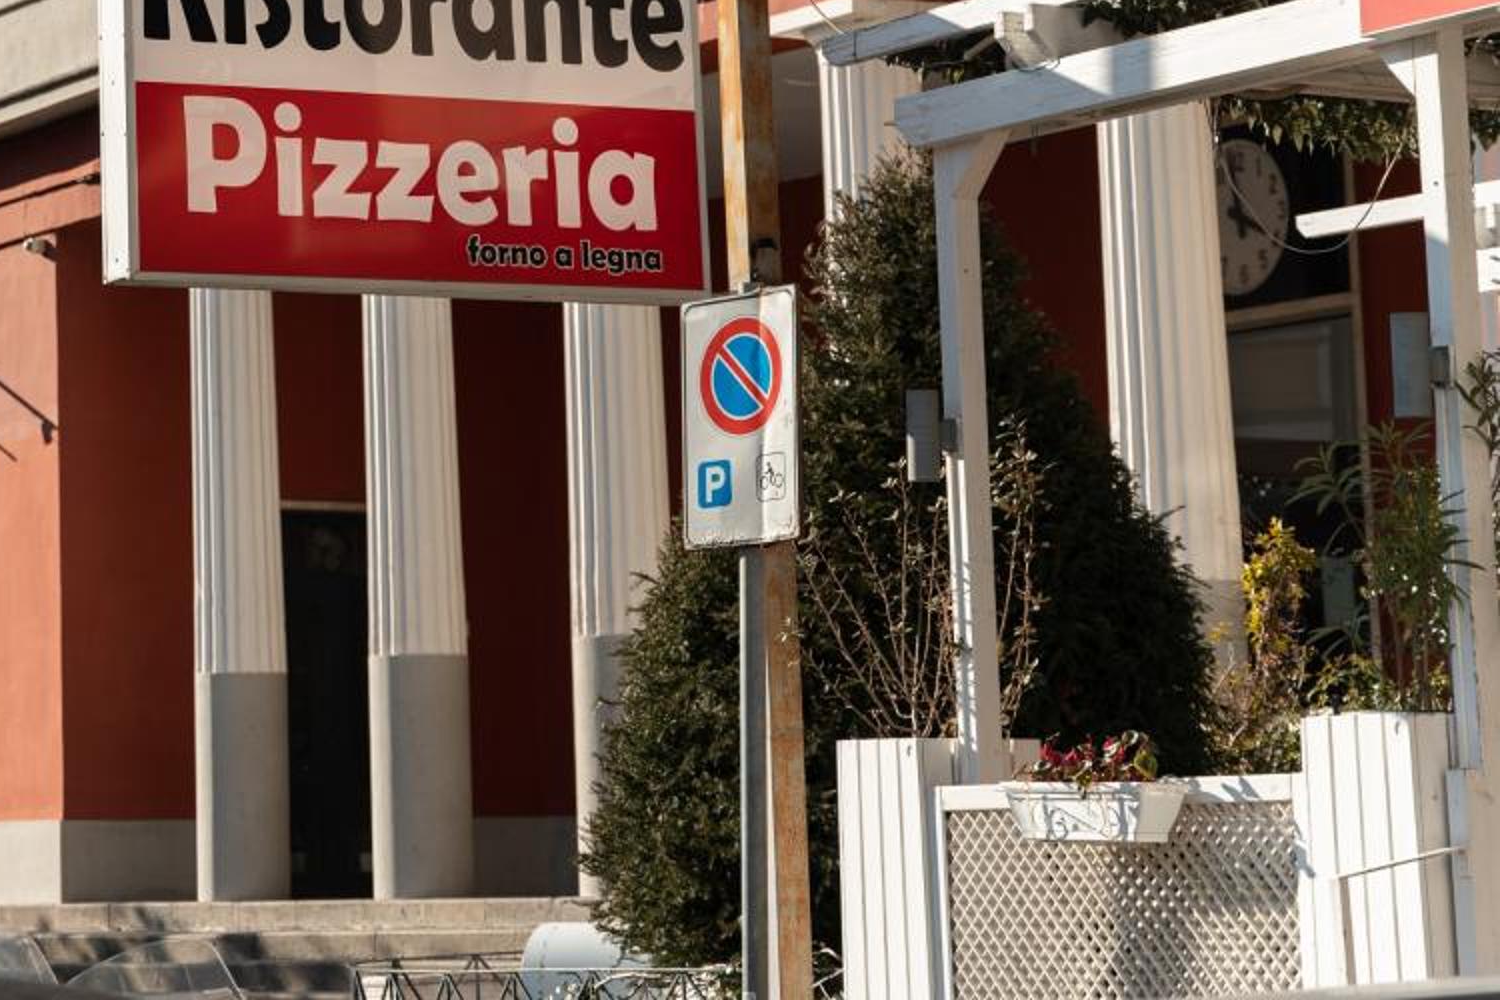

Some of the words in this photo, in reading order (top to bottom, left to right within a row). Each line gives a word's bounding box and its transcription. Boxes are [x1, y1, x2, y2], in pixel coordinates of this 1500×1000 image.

[183, 94, 658, 232] Pizzeria
[467, 233, 549, 268] forno
[554, 245, 575, 268] a
[579, 239, 663, 276] legna
[705, 465, 726, 504] P
